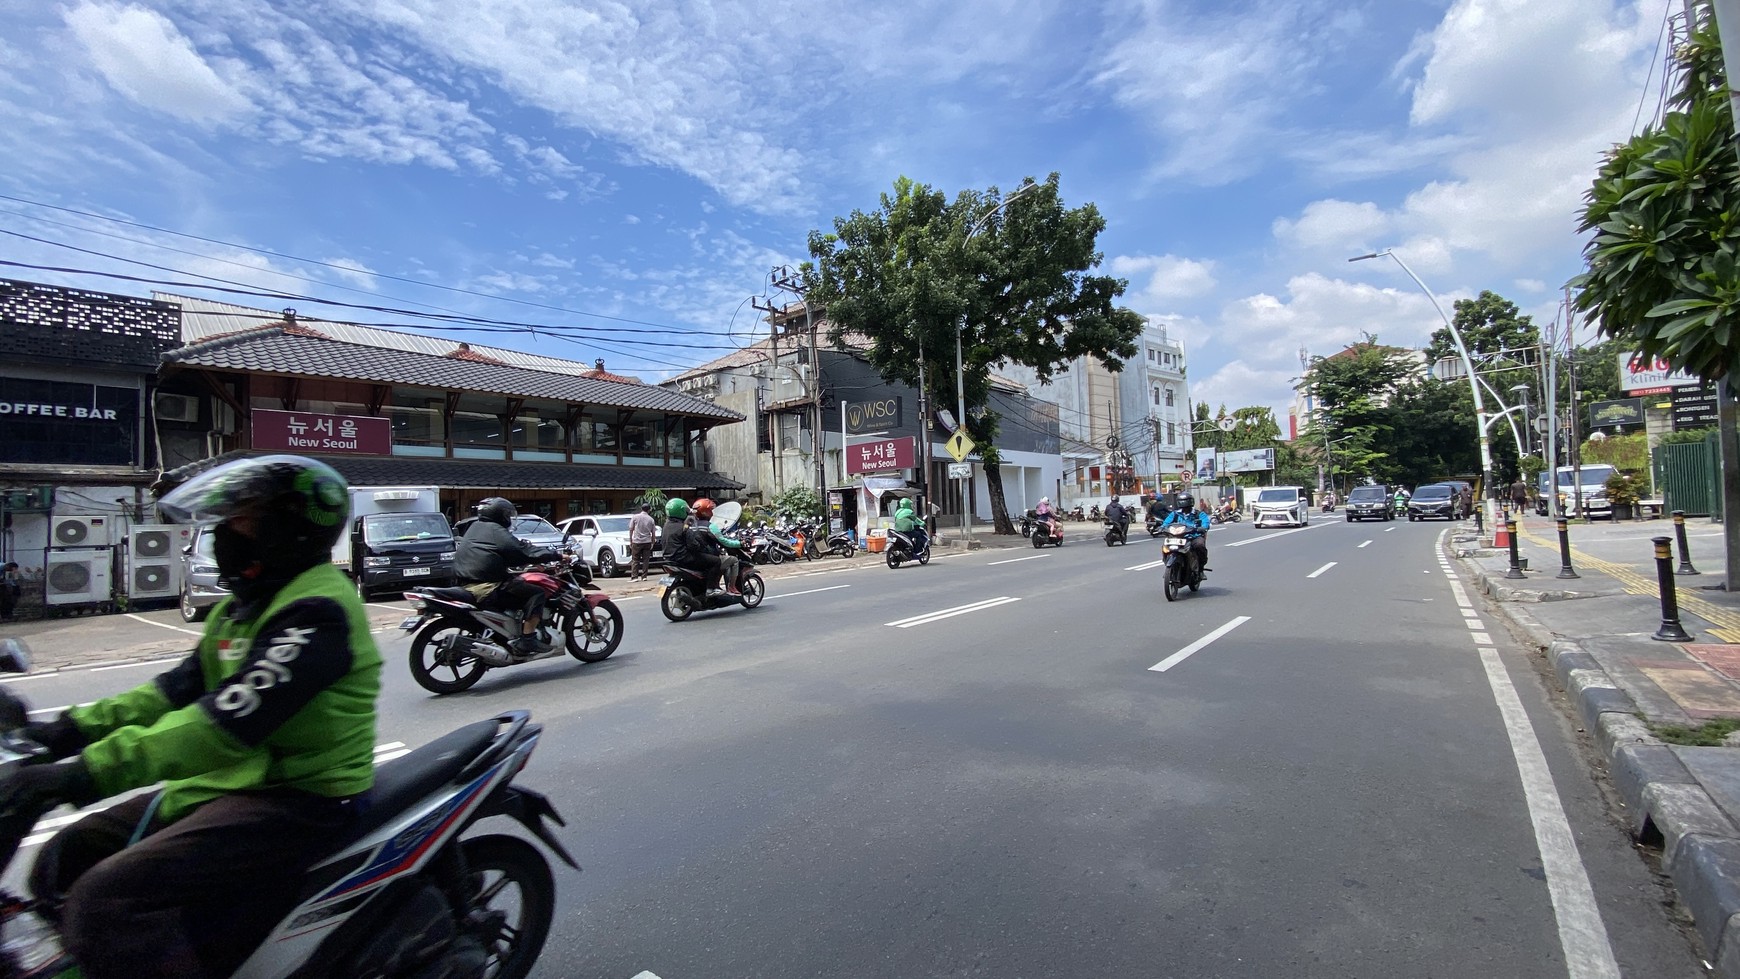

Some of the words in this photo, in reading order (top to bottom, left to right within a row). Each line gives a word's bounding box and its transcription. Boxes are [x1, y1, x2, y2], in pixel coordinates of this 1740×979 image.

[0, 402, 68, 417] OFFEE
[74, 407, 117, 420] BAR
[864, 400, 896, 419] WSC
[287, 416, 358, 438] 뉴서울
[288, 436, 320, 448] New
[322, 438, 357, 449] Seoul
[862, 442, 896, 460] 뉴서울
[878, 458, 896, 468] Seoul
[214, 627, 318, 718] gojek
